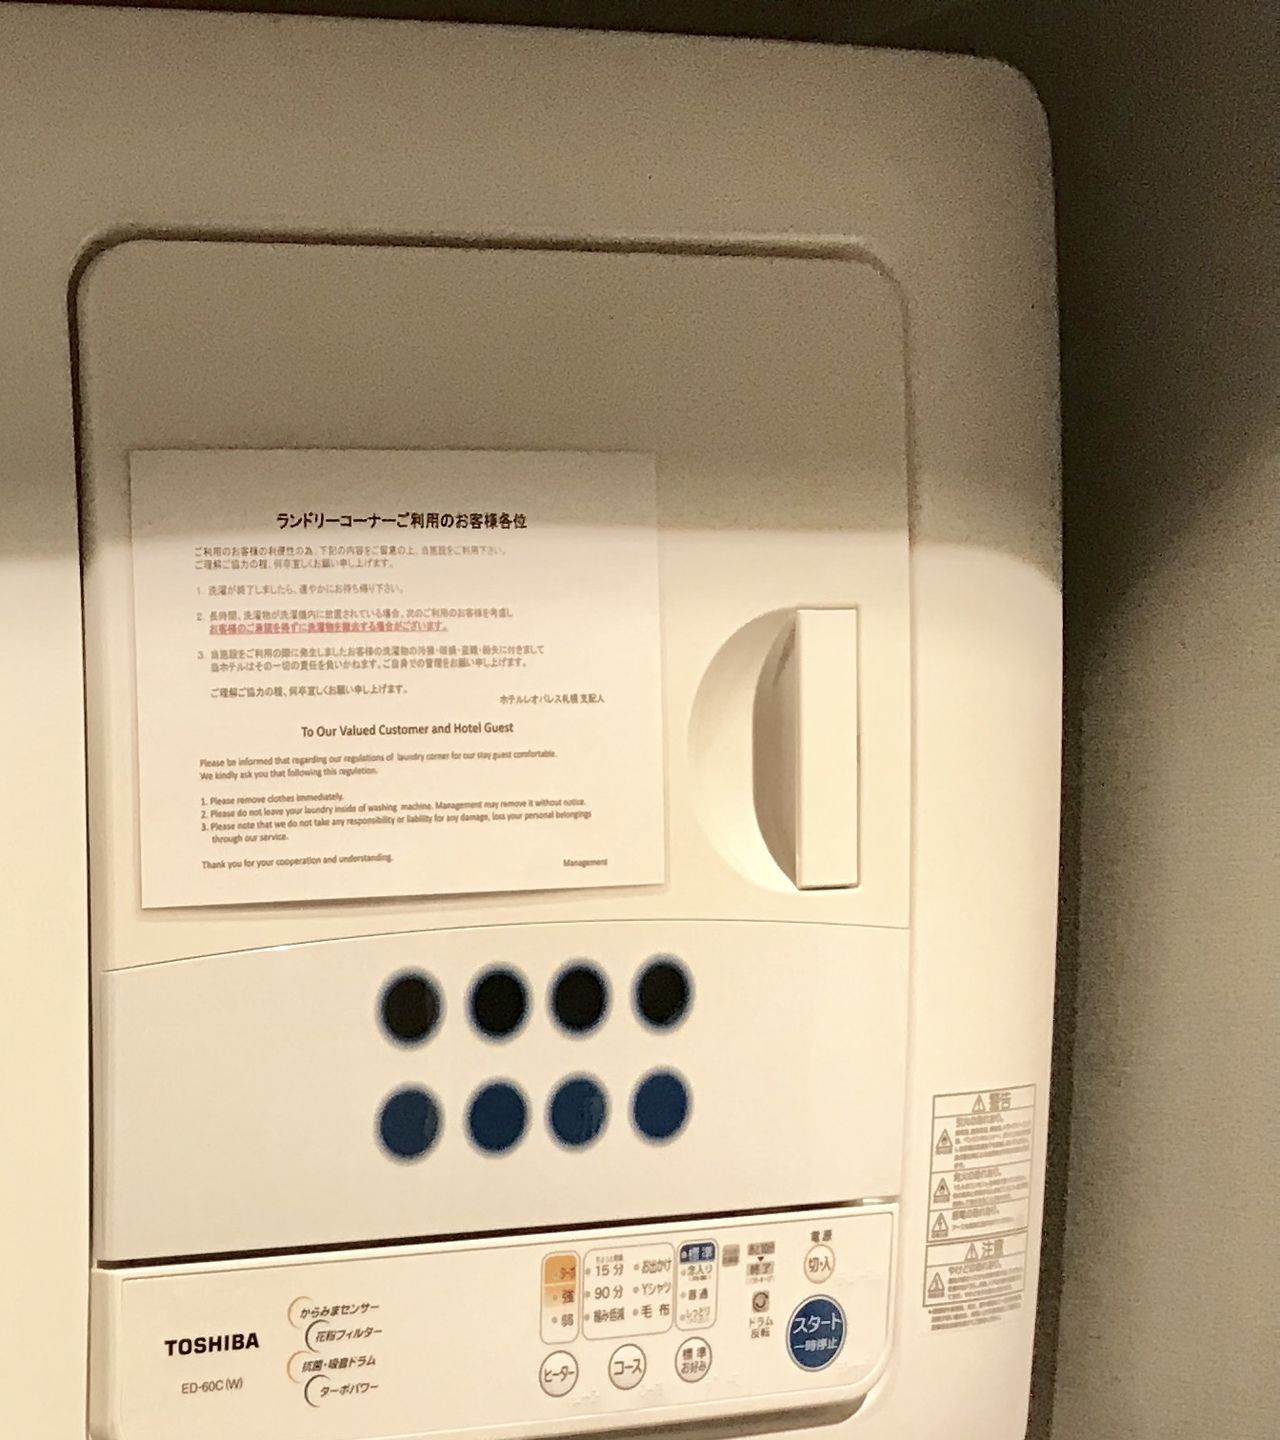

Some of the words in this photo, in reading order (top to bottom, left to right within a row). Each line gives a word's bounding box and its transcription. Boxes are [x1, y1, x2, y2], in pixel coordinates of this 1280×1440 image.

[276, 511, 528, 530] ランドリーコーナーご利用のお客様各位
[300, 726, 315, 738] To
[315, 725, 338, 738] Our
[339, 723, 377, 737] Valued
[378, 723, 429, 736] Customer
[431, 722, 452, 735] and
[453, 721, 482, 734] Hotel
[483, 721, 514, 734] Guest
[300, 1303, 380, 1319] からみまセンサー
[792, 1311, 842, 1335] スタート
[164, 1332, 260, 1357] TOSHIBA
[320, 1382, 379, 1398] ターボパワー
